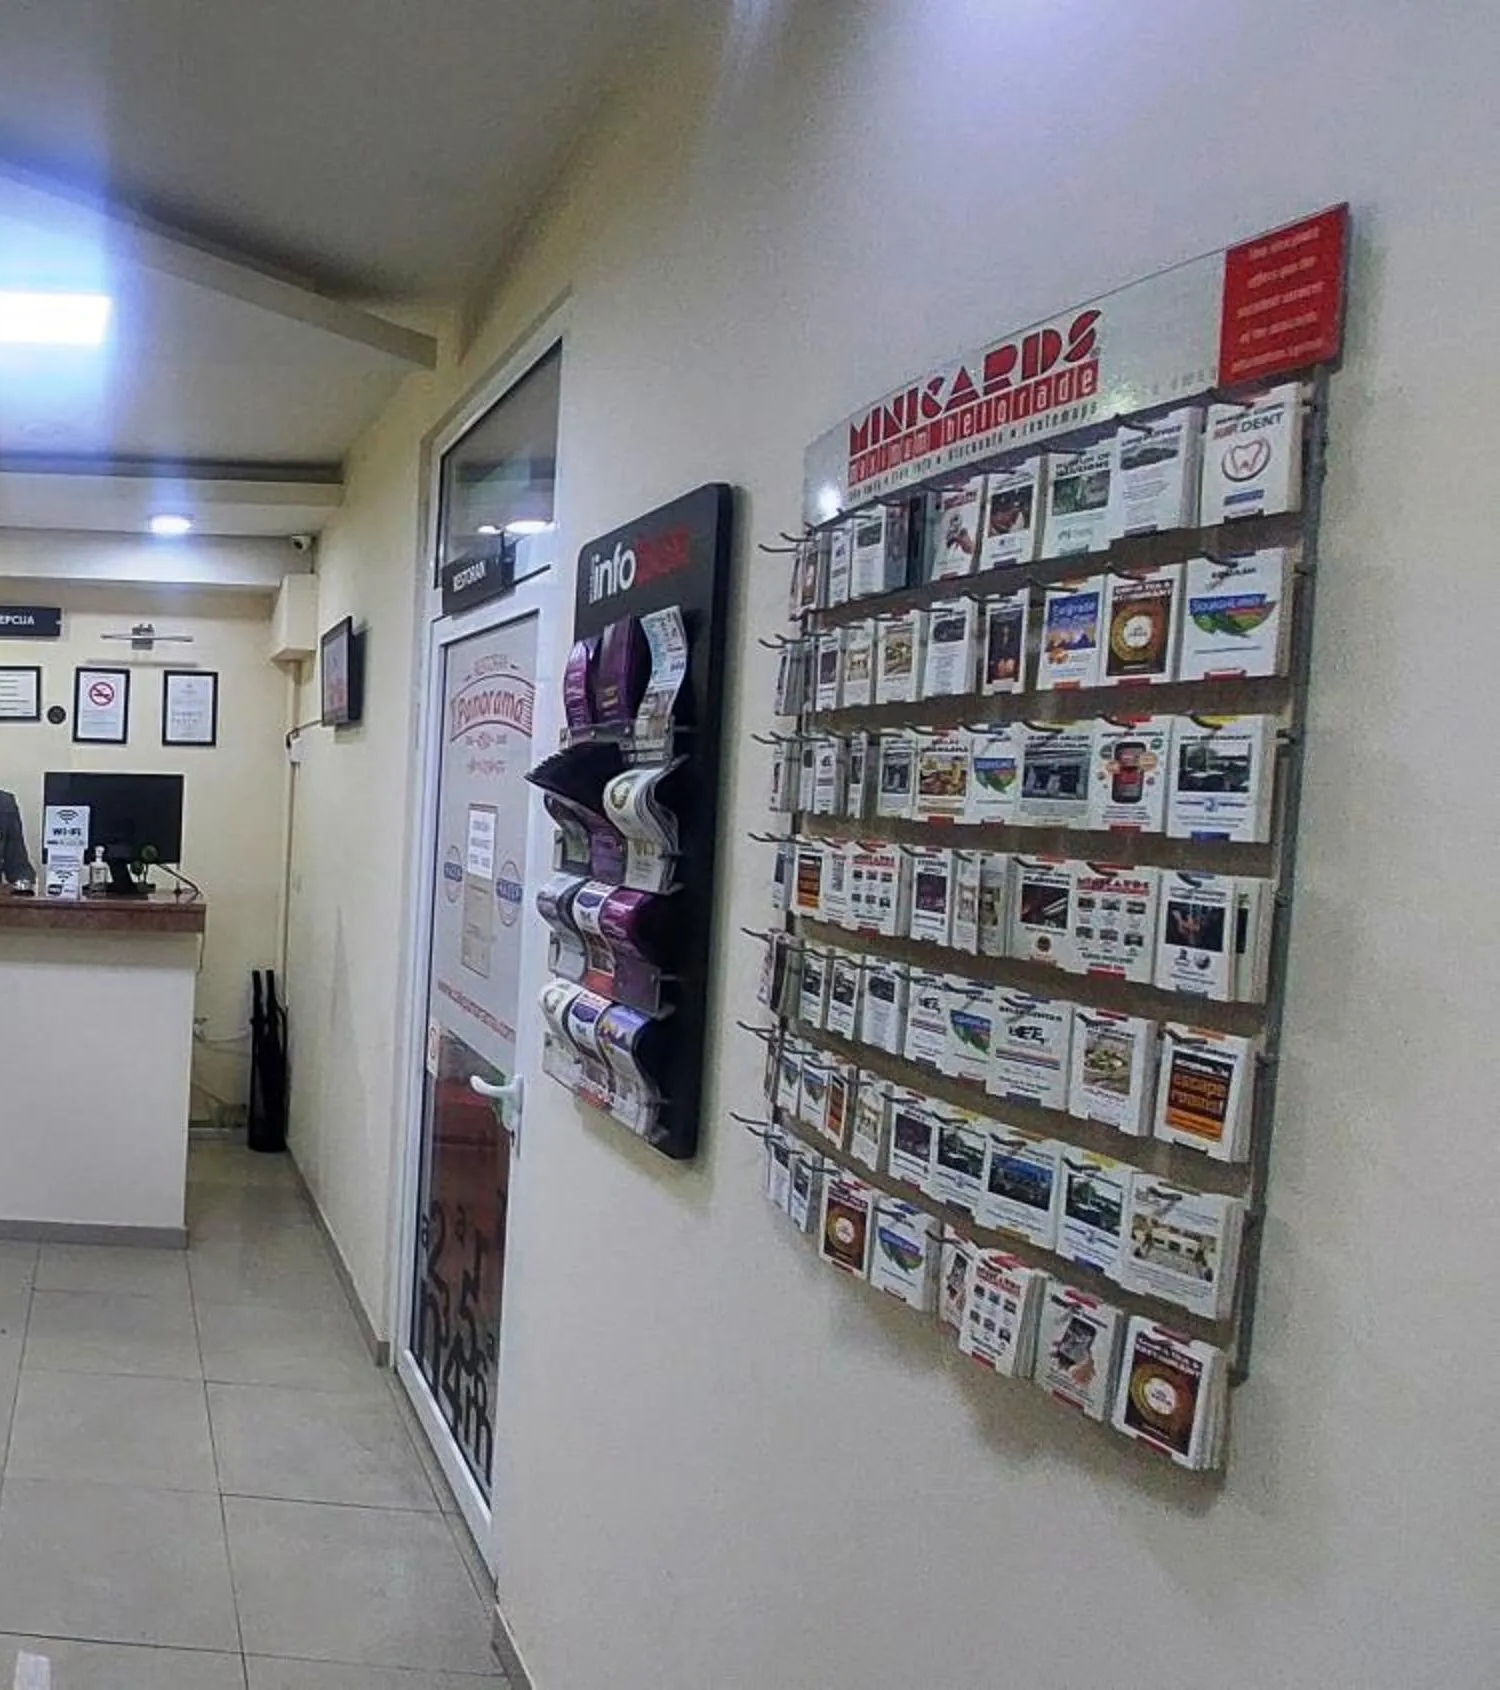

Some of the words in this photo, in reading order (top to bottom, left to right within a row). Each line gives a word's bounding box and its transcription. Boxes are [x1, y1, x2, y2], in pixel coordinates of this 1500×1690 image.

[850, 309, 1102, 457] MINICARDS
[947, 365, 1094, 444] belgrade
[457, 690, 524, 731] Panorama
